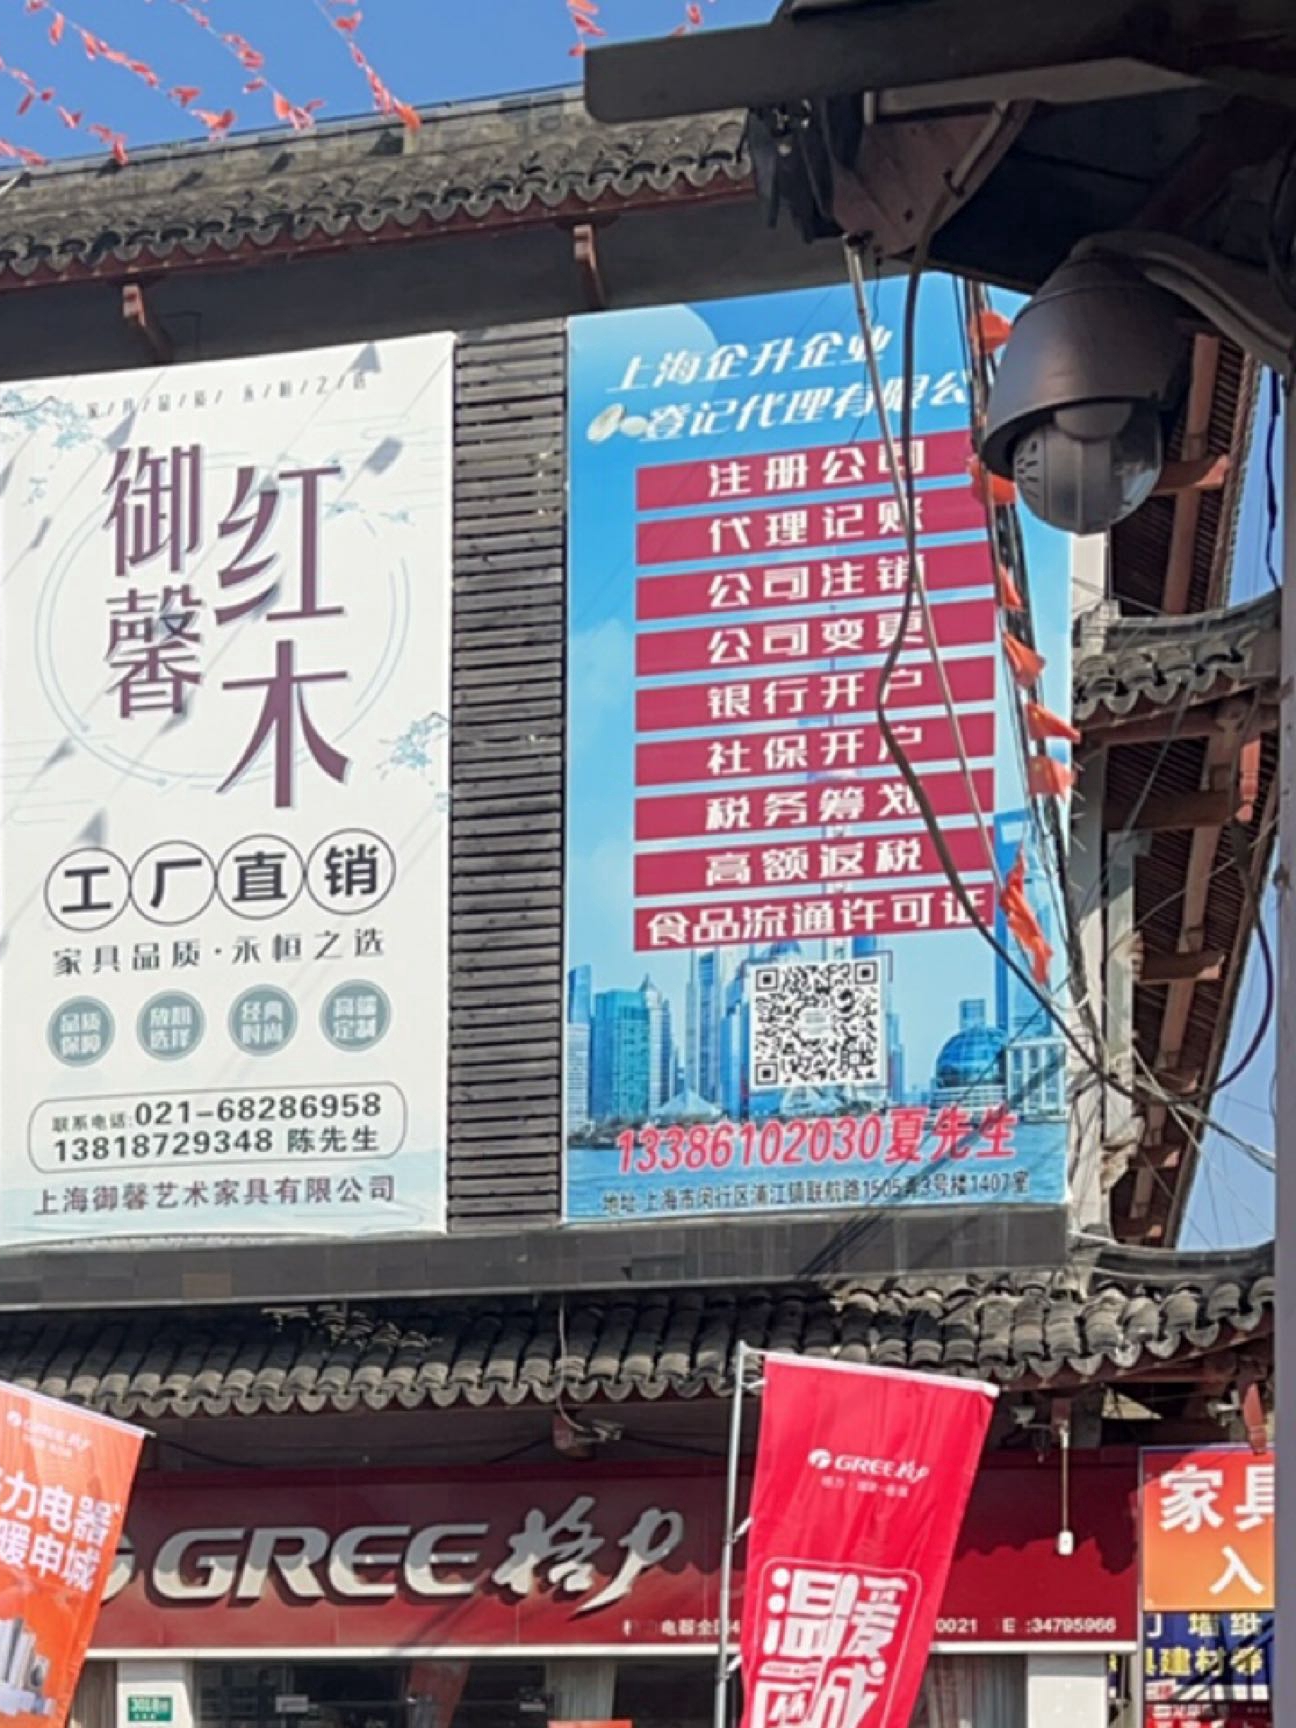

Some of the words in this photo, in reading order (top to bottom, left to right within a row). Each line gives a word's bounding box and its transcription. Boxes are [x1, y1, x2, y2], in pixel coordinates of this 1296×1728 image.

[639, 368, 994, 442] 登记代理有限公
[708, 440, 925, 498] 注册公司
[708, 497, 923, 553] 代理记账
[214, 465, 350, 810] 红木
[708, 610, 924, 664] 公司变更
[707, 669, 923, 719] 银行开户
[706, 726, 923, 775] 社保开户
[705, 783, 922, 831] 税务筹划
[60, 844, 381, 914] 工厂直销
[705, 838, 922, 887] 高额返税
[647, 889, 986, 947] 食品流通许可证
[135, 1092, 383, 1127] 021-68286958
[53, 1129, 274, 1162] 13818729348
[287, 1126, 380, 1153] 陈先生
[153, 1524, 489, 1600] GREE
[1208, 1545, 1265, 1594] 入
